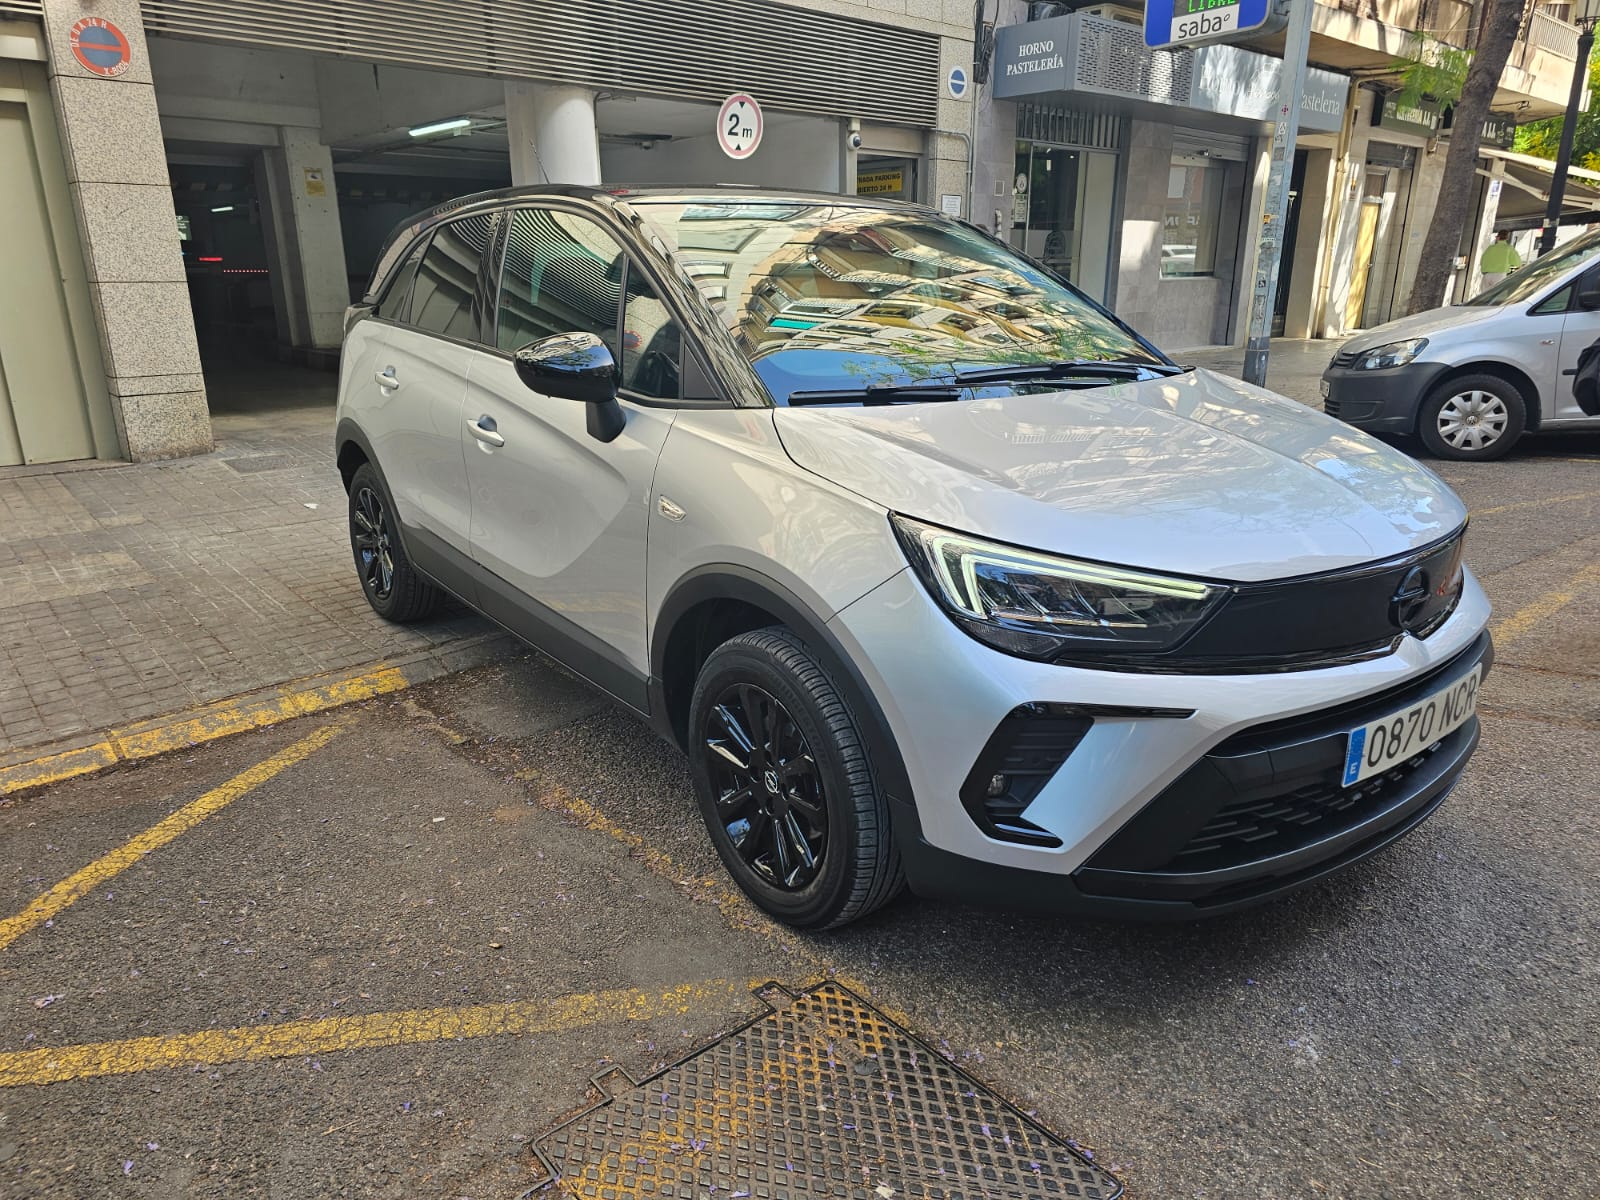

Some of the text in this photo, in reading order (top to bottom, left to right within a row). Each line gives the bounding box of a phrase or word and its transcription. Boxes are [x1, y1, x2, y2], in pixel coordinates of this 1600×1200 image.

[1018, 40, 1054, 57] HORNO
[1006, 53, 1064, 76] PASTELERÍA
[1301, 88, 1340, 116] asteleria
[728, 113, 753, 139] 2 m
[875, 172, 901, 181] PARKING
[1367, 673, 1477, 768] 0870 NCR
[1350, 762, 1357, 774] E
